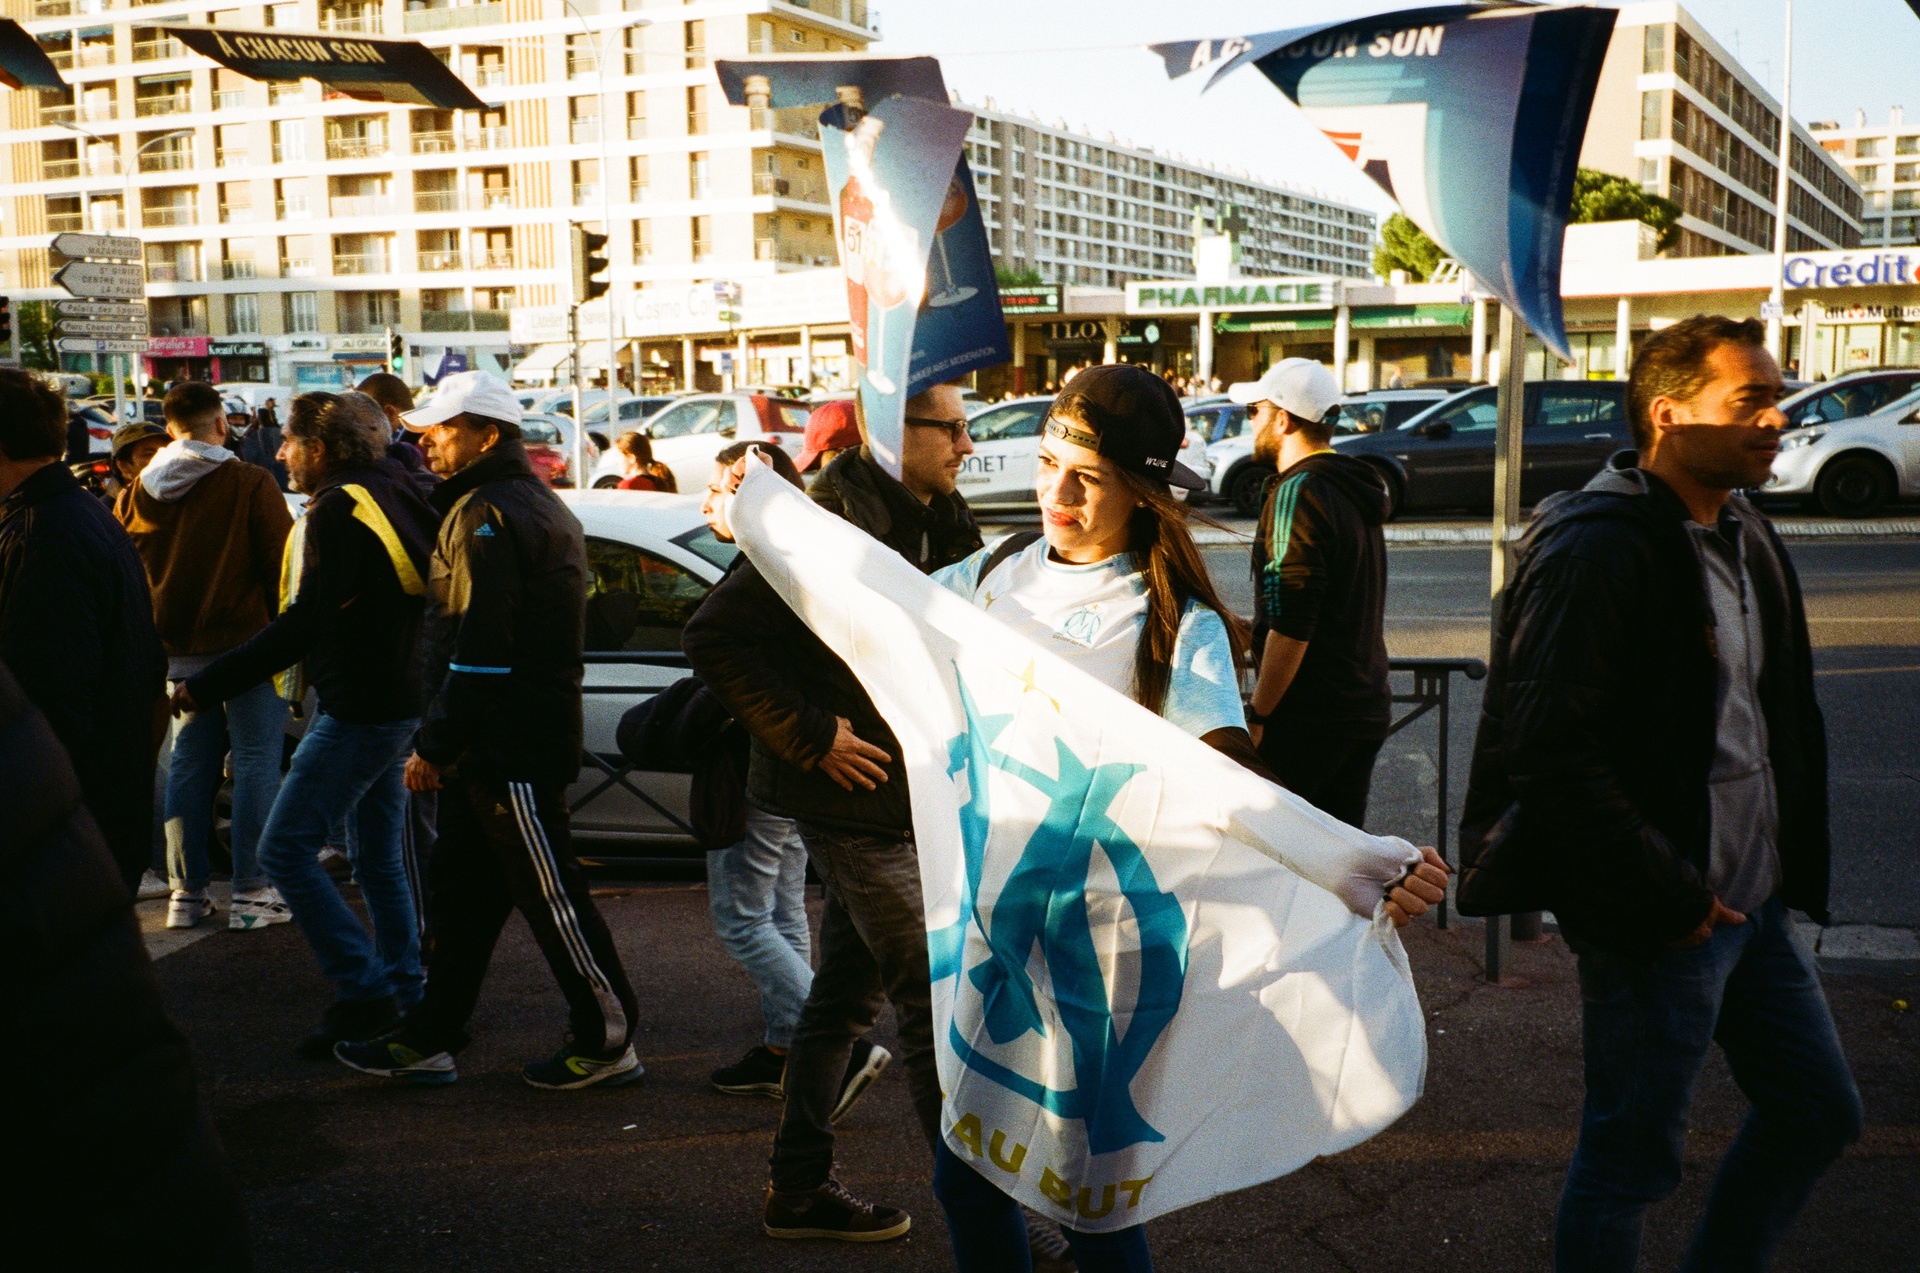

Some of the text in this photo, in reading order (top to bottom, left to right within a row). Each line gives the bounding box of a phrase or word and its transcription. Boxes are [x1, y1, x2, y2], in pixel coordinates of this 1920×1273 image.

[235, 35, 333, 62] CHACUN
[330, 41, 386, 63] SON
[1368, 25, 1444, 57] SON
[82, 276, 114, 285] CENTRE
[1784, 254, 1909, 288] Crédit
[1138, 284, 1322, 308] PHARMACIE
[954, 1112, 1154, 1219] AU BUT
